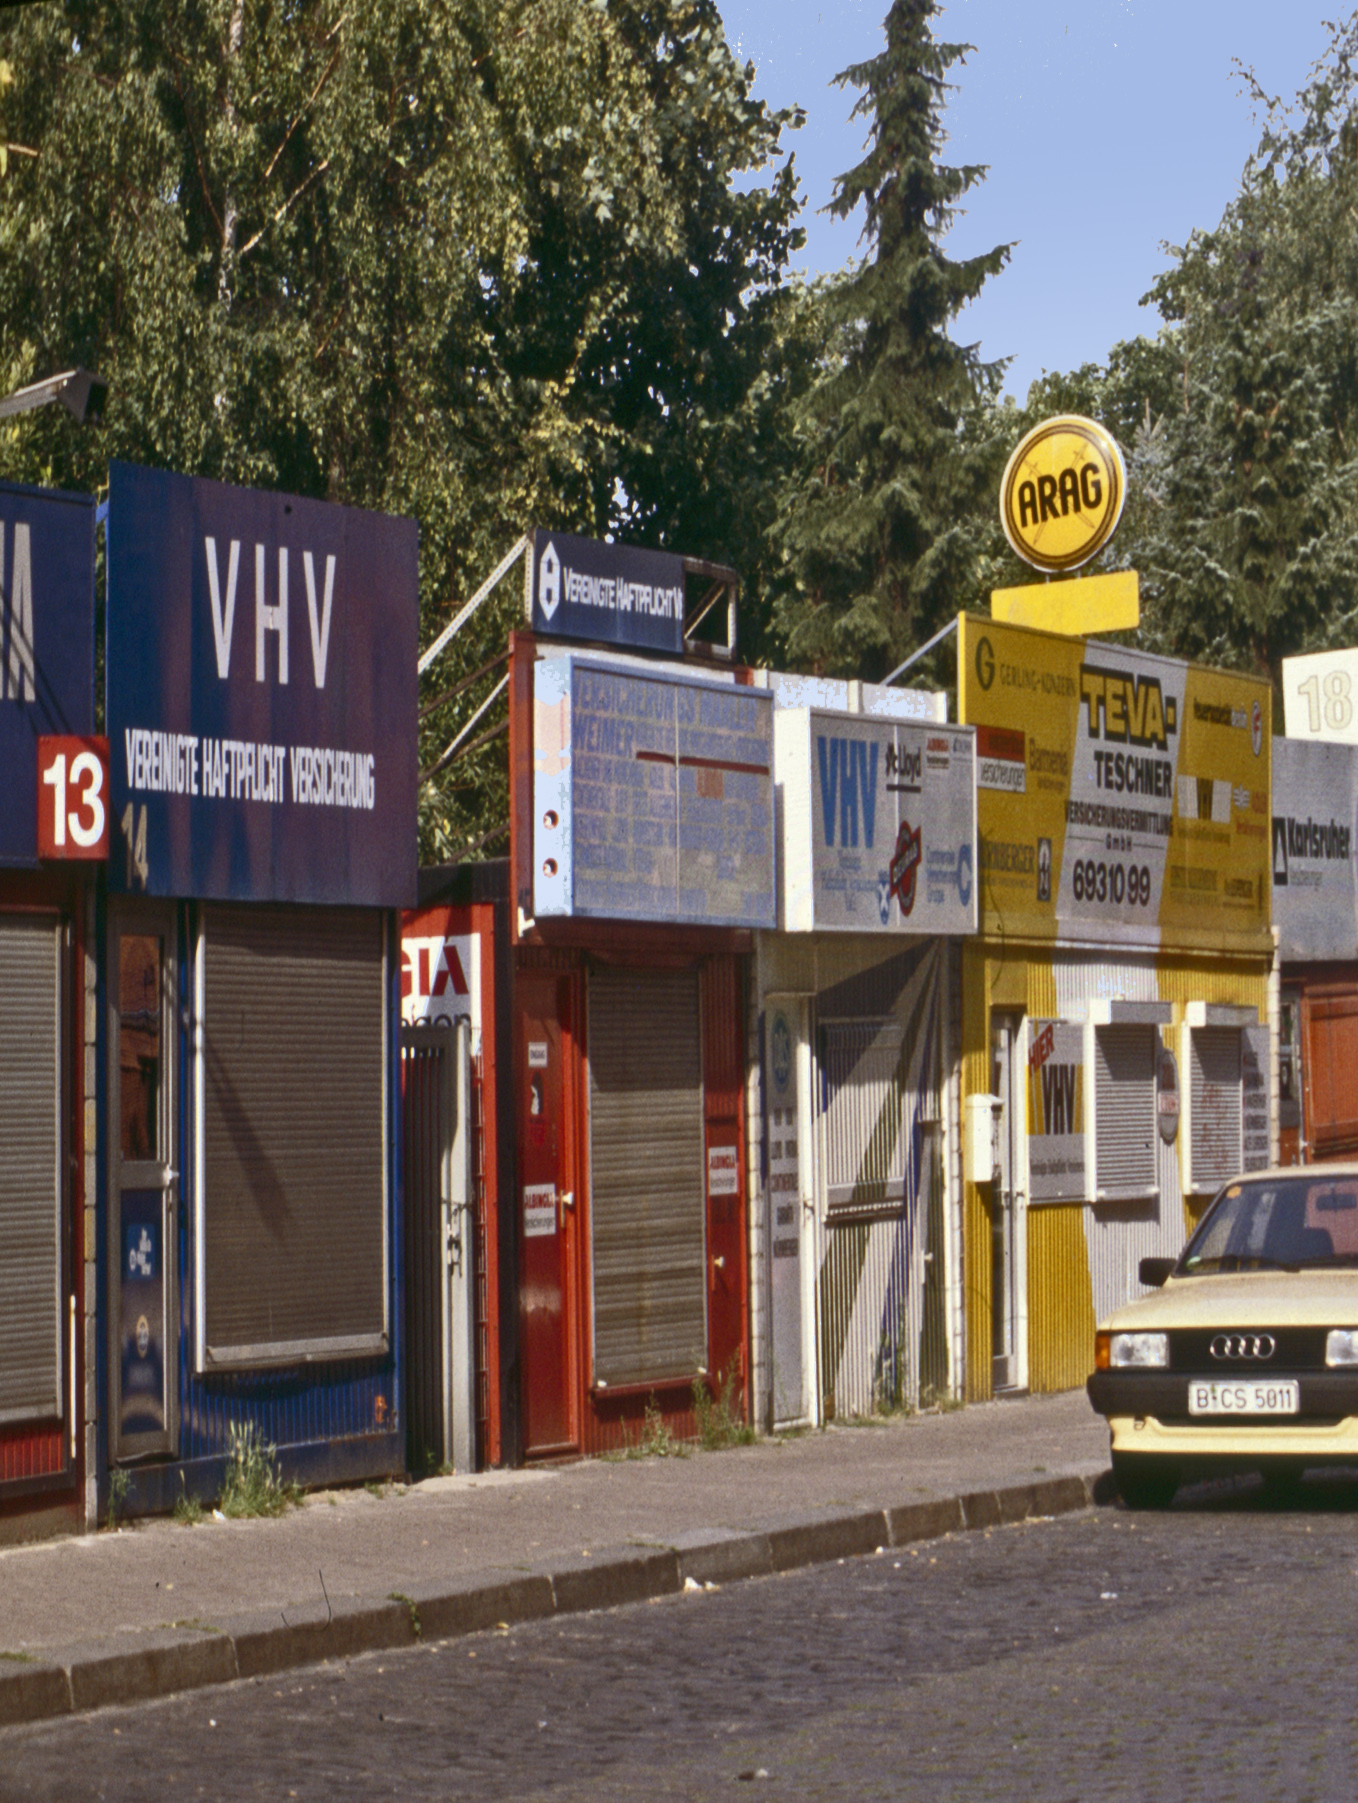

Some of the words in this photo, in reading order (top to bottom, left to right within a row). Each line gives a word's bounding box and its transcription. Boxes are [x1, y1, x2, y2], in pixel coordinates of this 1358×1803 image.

[1018, 462, 1102, 528] ARAG
[205, 536, 336, 689] VHV
[1297, 670, 1353, 732] 18
[43, 752, 105, 847] 13
[125, 728, 199, 796] VEREINIGTE
[202, 738, 286, 803] HAFTPFLICHT
[290, 746, 375, 810] VERSICHERUNG
[817, 736, 878, 848] VHV
[1094, 750, 1172, 798] TESCHNER
[120, 802, 148, 889] 14
[1287, 817, 1350, 859] Karlsruher
[1028, 1023, 1055, 1077] HIER
[1041, 1064, 1076, 1135] VHV
[1196, 1388, 1209, 1409] B
[1221, 1388, 1247, 1409] CS
